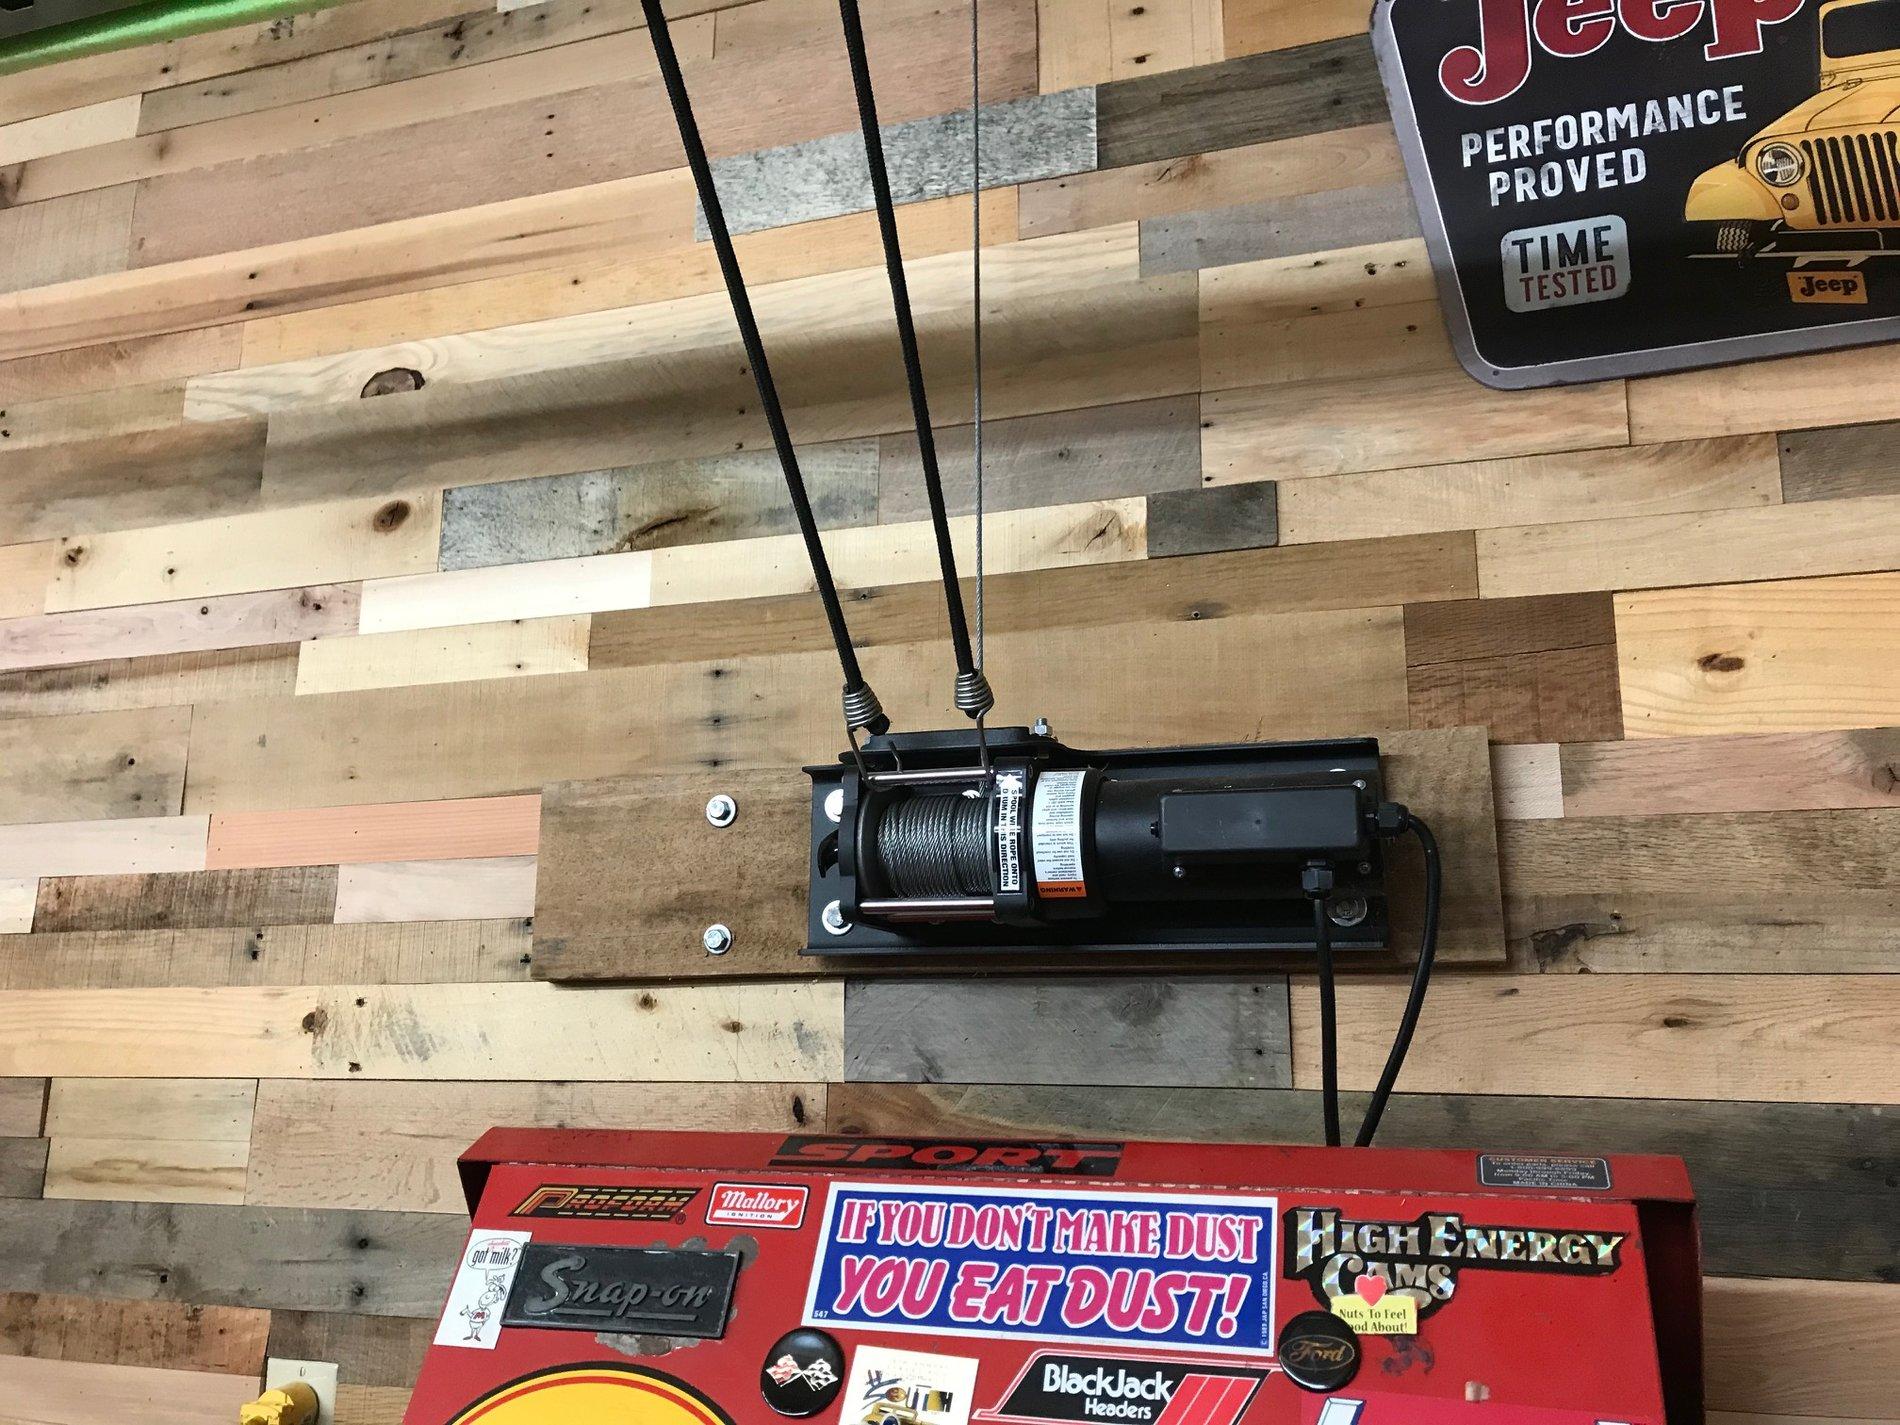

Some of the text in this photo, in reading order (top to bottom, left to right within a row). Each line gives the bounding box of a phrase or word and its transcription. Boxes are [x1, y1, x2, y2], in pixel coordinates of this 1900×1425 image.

[1461, 85, 1747, 168] PERFORMANCE
[1489, 147, 1648, 207] PROVED
[1511, 225, 1616, 275] TIME
[1519, 264, 1618, 303] TESTED
[1800, 275, 1858, 297] Jeep
[1000, 813, 1008, 821] IN
[1008, 816, 1017, 837] WIE
[1000, 823, 1008, 842] TIS
[1009, 838, 1018, 861] ROPE
[1000, 844, 1009, 887] DIRECTION
[1010, 863, 1019, 886] ONTO
[798, 1143, 1119, 1169] SPORT
[513, 1187, 690, 1215] PROFORM
[721, 1190, 799, 1213] Mallory
[837, 1198, 1264, 1265] IF YOU DON'T MAKE DUST
[1296, 1209, 1625, 1272] HIGH ENERGY
[471, 1247, 518, 1267] got milk?
[523, 1255, 713, 1316] Snap-on
[1322, 1253, 1456, 1300] CAMS
[831, 1254, 1254, 1338] YOU EAT DUST!
[813, 1310, 829, 1318] 547
[1339, 1308, 1407, 1320] Nuts To Feel
[1350, 1321, 1408, 1333] ood About!
[1289, 1340, 1347, 1362] Ford
[1042, 1363, 1174, 1401] BlackJack
[1085, 1397, 1152, 1420] Headers
